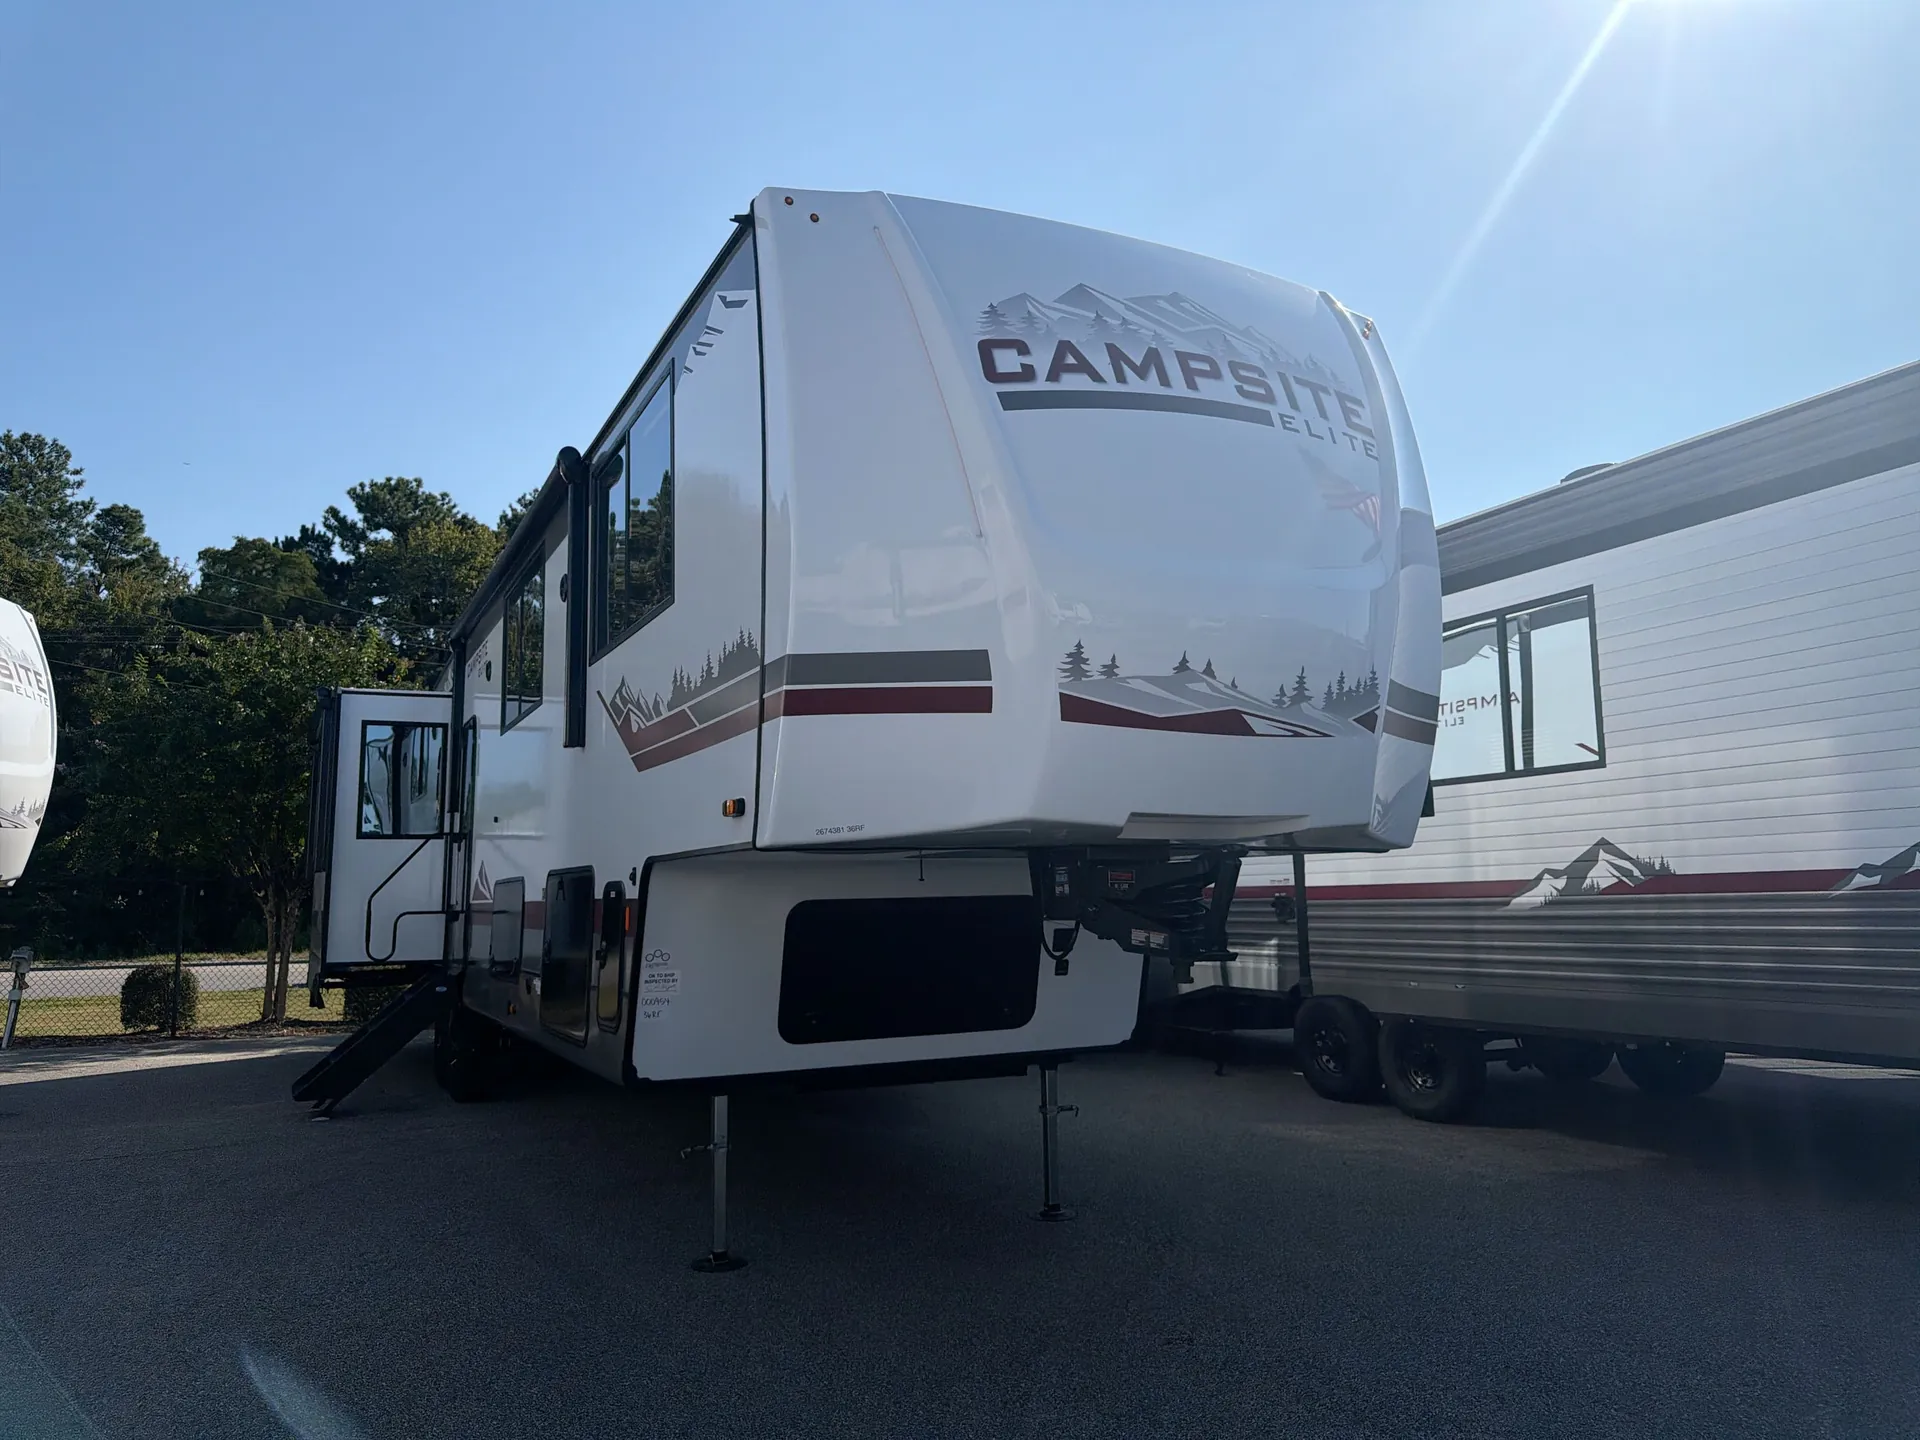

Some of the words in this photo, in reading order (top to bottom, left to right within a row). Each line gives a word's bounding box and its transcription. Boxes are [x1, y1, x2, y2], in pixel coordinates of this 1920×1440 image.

[977, 337, 1376, 440] CAMPSITE
[1277, 412, 1380, 462] ELITE
[15, 684, 49, 708] ELITE
[815, 826, 845, 836] 2674381
[846, 824, 865, 833] 36RF
